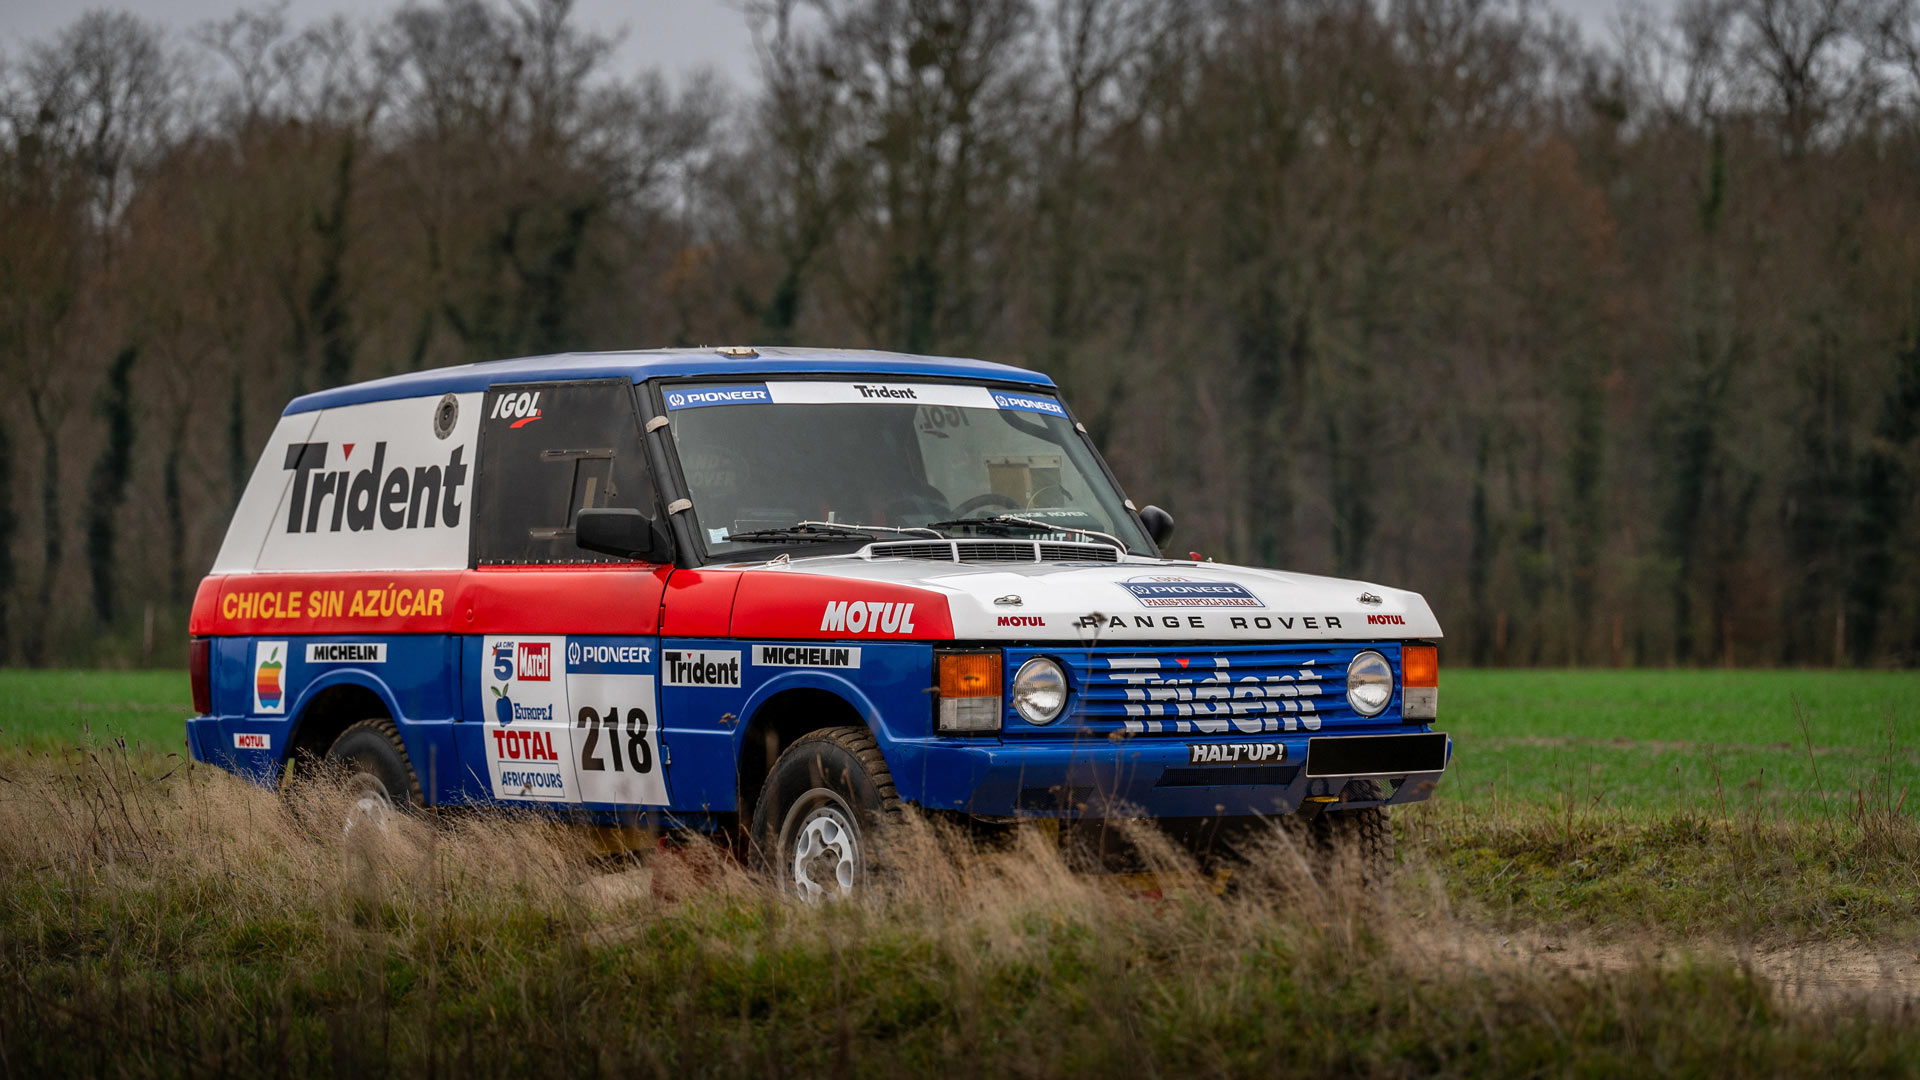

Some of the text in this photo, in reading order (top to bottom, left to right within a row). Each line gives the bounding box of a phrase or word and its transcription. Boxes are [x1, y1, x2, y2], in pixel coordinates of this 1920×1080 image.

[687, 391, 766, 403] PIONEER
[853, 385, 917, 399] Trident
[490, 391, 541, 419] IGOL
[1008, 398, 1063, 413] PIONEER
[283, 441, 468, 533] Trident
[1150, 585, 1242, 594] PIONEER
[223, 583, 445, 620] CHICLE SIN AZÚCAR
[1144, 598, 1258, 606] PARIS-TRIPOLI-DAKAR
[820, 600, 915, 633] MOTUL
[997, 616, 1046, 626] MOTUL
[1079, 616, 1342, 629] RANGE ROVER
[1367, 615, 1406, 625] MOTUL
[313, 645, 378, 661] MICHELIN
[519, 647, 549, 677] MATCH
[583, 646, 651, 663] PIONEER
[763, 647, 849, 666] MICHELIN
[493, 649, 513, 681] 5
[665, 652, 738, 685] Trident
[1107, 657, 1323, 734] Trident
[238, 735, 264, 748] MOTUL
[493, 730, 558, 760] TOTAL
[577, 706, 652, 774] 218
[501, 771, 563, 789] AFRICATOURS
